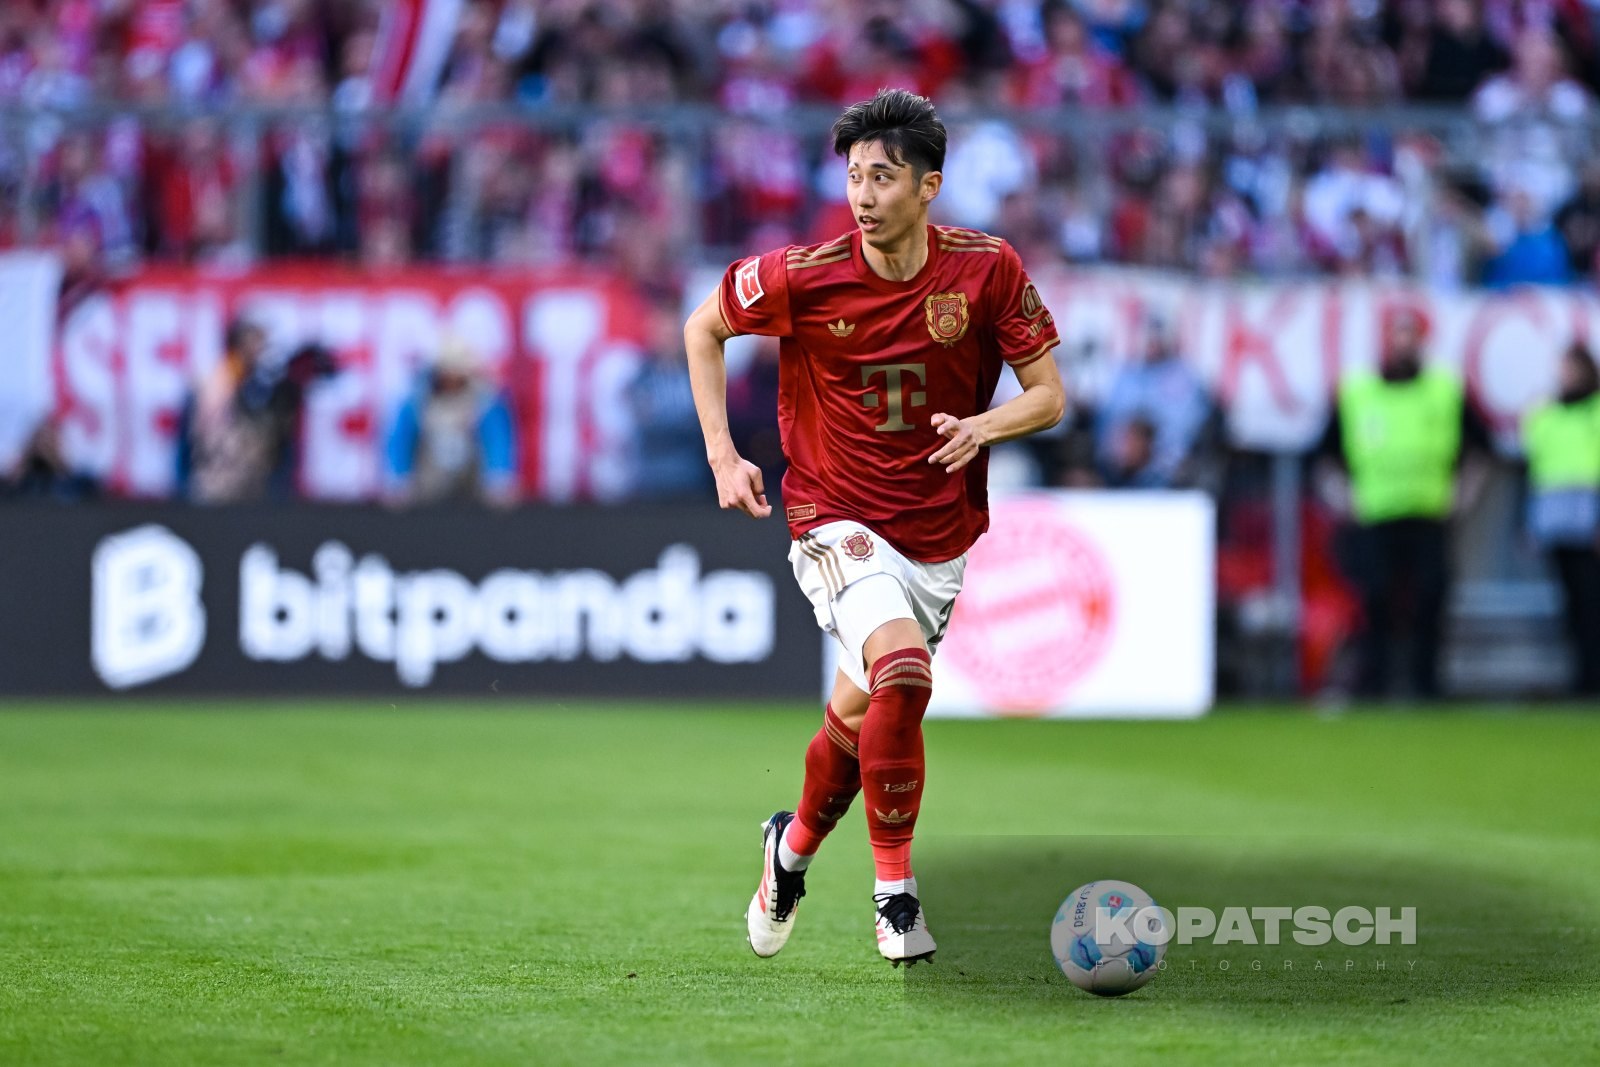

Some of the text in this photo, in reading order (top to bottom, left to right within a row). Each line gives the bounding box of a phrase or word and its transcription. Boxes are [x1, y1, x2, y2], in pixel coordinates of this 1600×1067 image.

[937, 302, 958, 314] 125
[861, 362, 926, 432] T
[239, 541, 775, 686] bitpanda
[883, 780, 918, 793] 125
